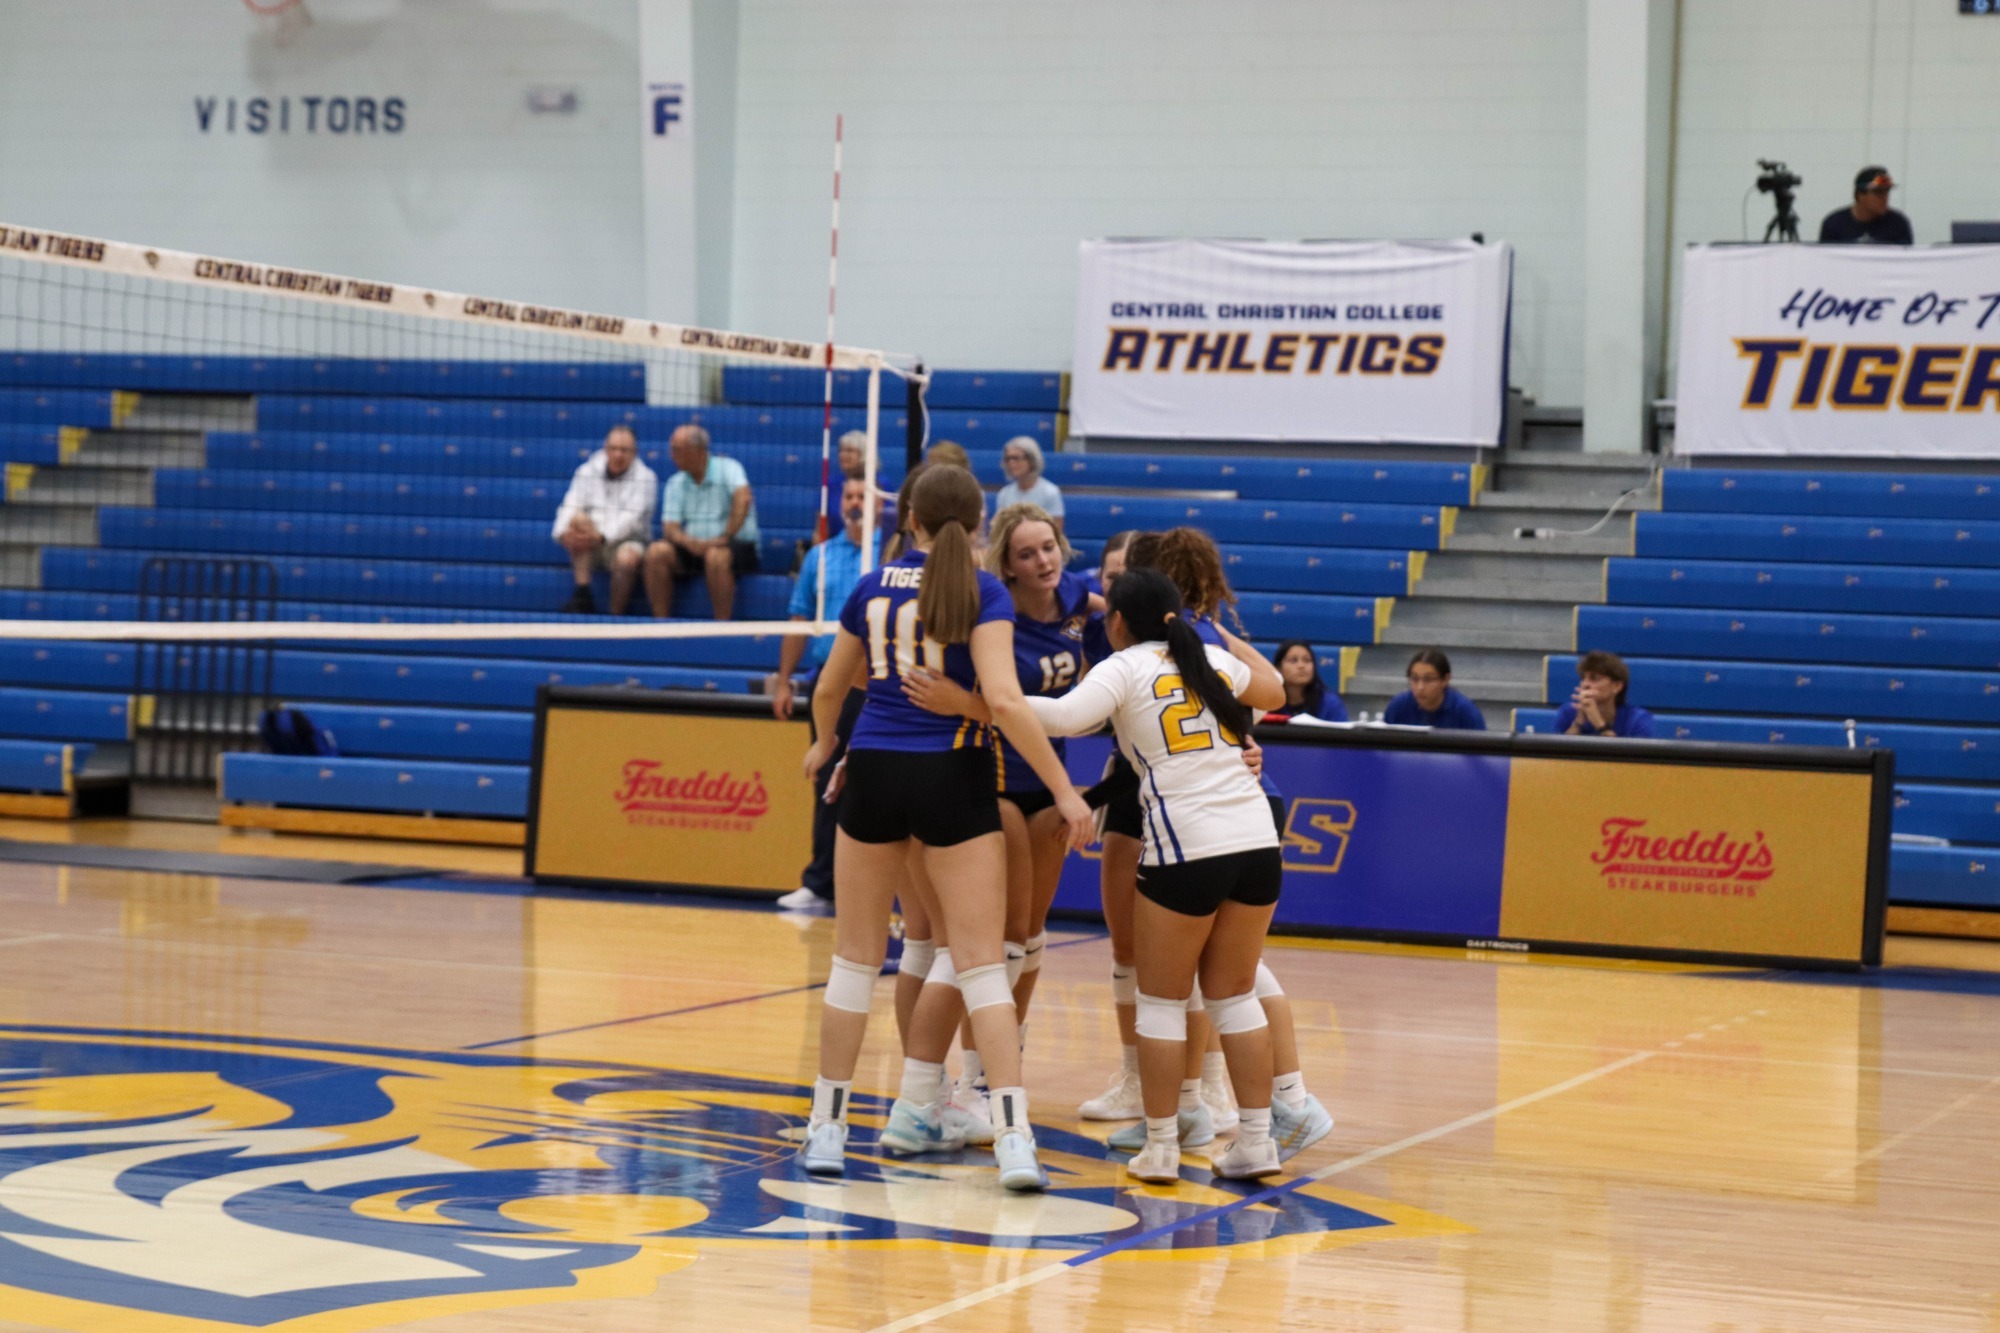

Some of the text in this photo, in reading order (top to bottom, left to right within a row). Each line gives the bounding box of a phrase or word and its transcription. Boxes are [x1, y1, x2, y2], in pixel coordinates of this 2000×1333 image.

[195, 96, 407, 134] VISITORS
[653, 95, 681, 134] F
[47, 234, 105, 262] TIGERS
[195, 258, 393, 303] CENTRAL CHRISTIAN TIGERS
[464, 296, 517, 321] CENTRAL
[520, 306, 583, 329] CHRISTIAN
[1111, 302, 1443, 321] CENTRAL CHRISTIAN COLLEGE
[1780, 288, 2000, 330] HOME OF T
[1100, 326, 1445, 375] ATHLETICS
[880, 566, 924, 589] TIGE
[1039, 651, 1076, 692] 12
[613, 758, 769, 818] Freddy's
[1590, 816, 1776, 881] Freddy's
[1607, 876, 1757, 898] STEAKBURGERS
